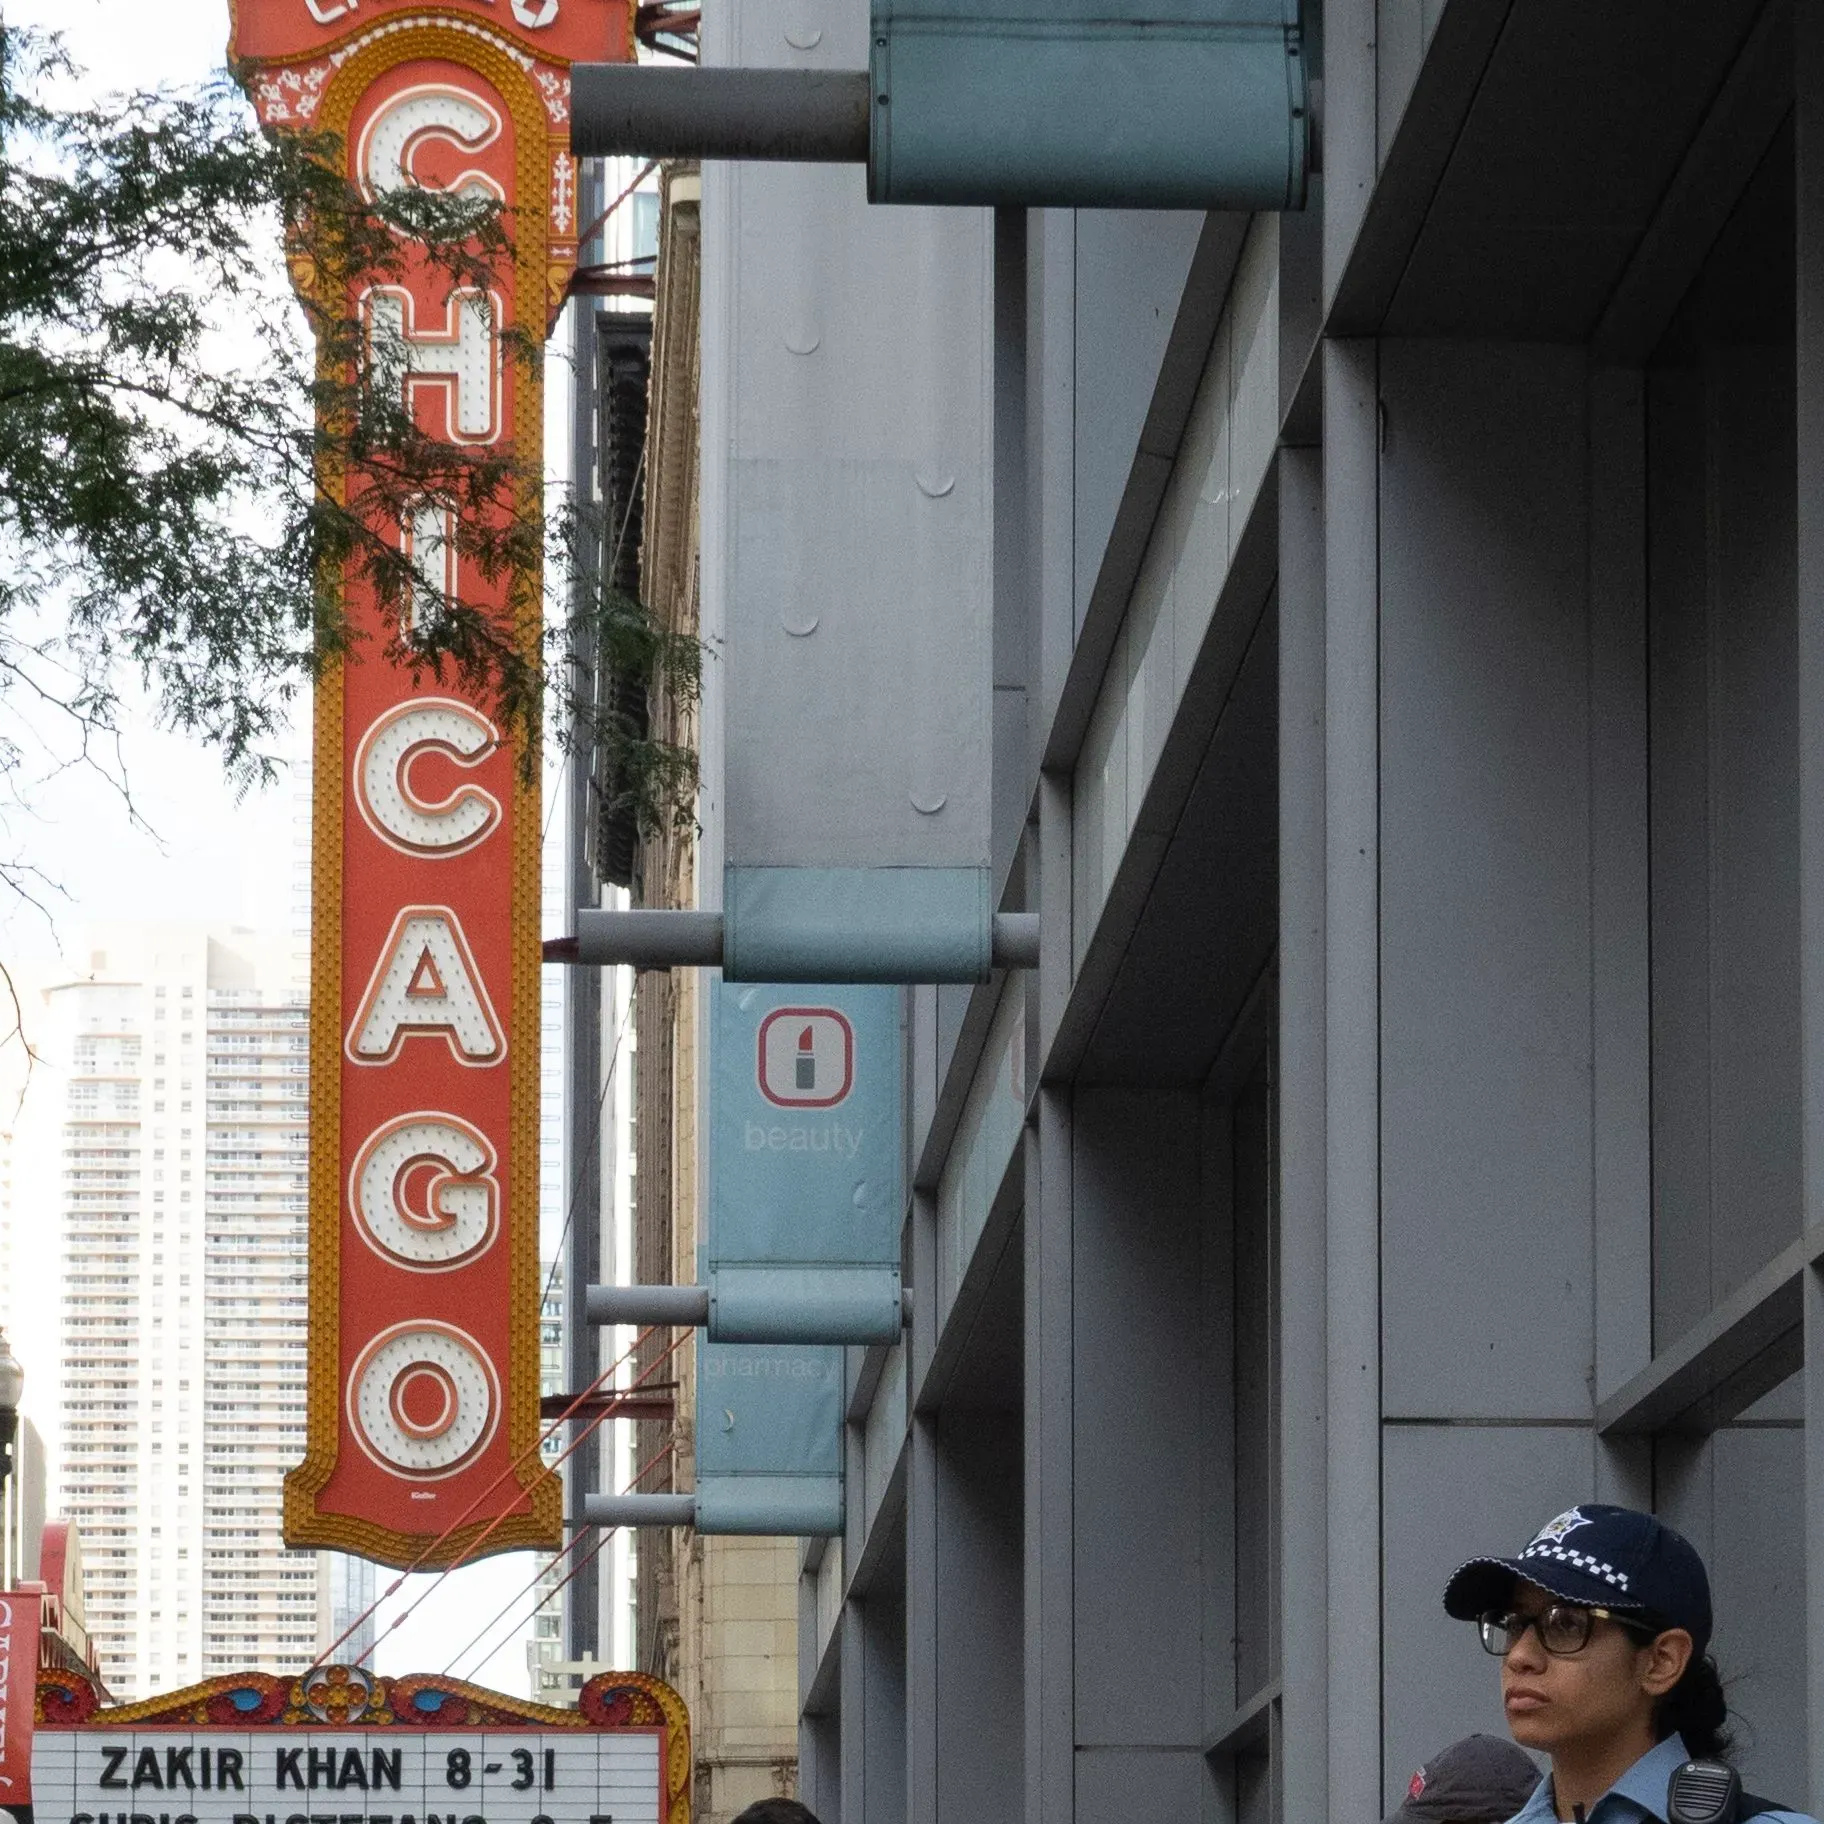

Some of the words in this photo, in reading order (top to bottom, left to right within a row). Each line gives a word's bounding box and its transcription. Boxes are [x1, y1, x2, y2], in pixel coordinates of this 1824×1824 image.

[745, 1120, 865, 1159] beauty
[99, 1746, 245, 1790] ZAKIR
[276, 1747, 402, 1791] KHAN
[445, 1747, 556, 1791] 8-31
